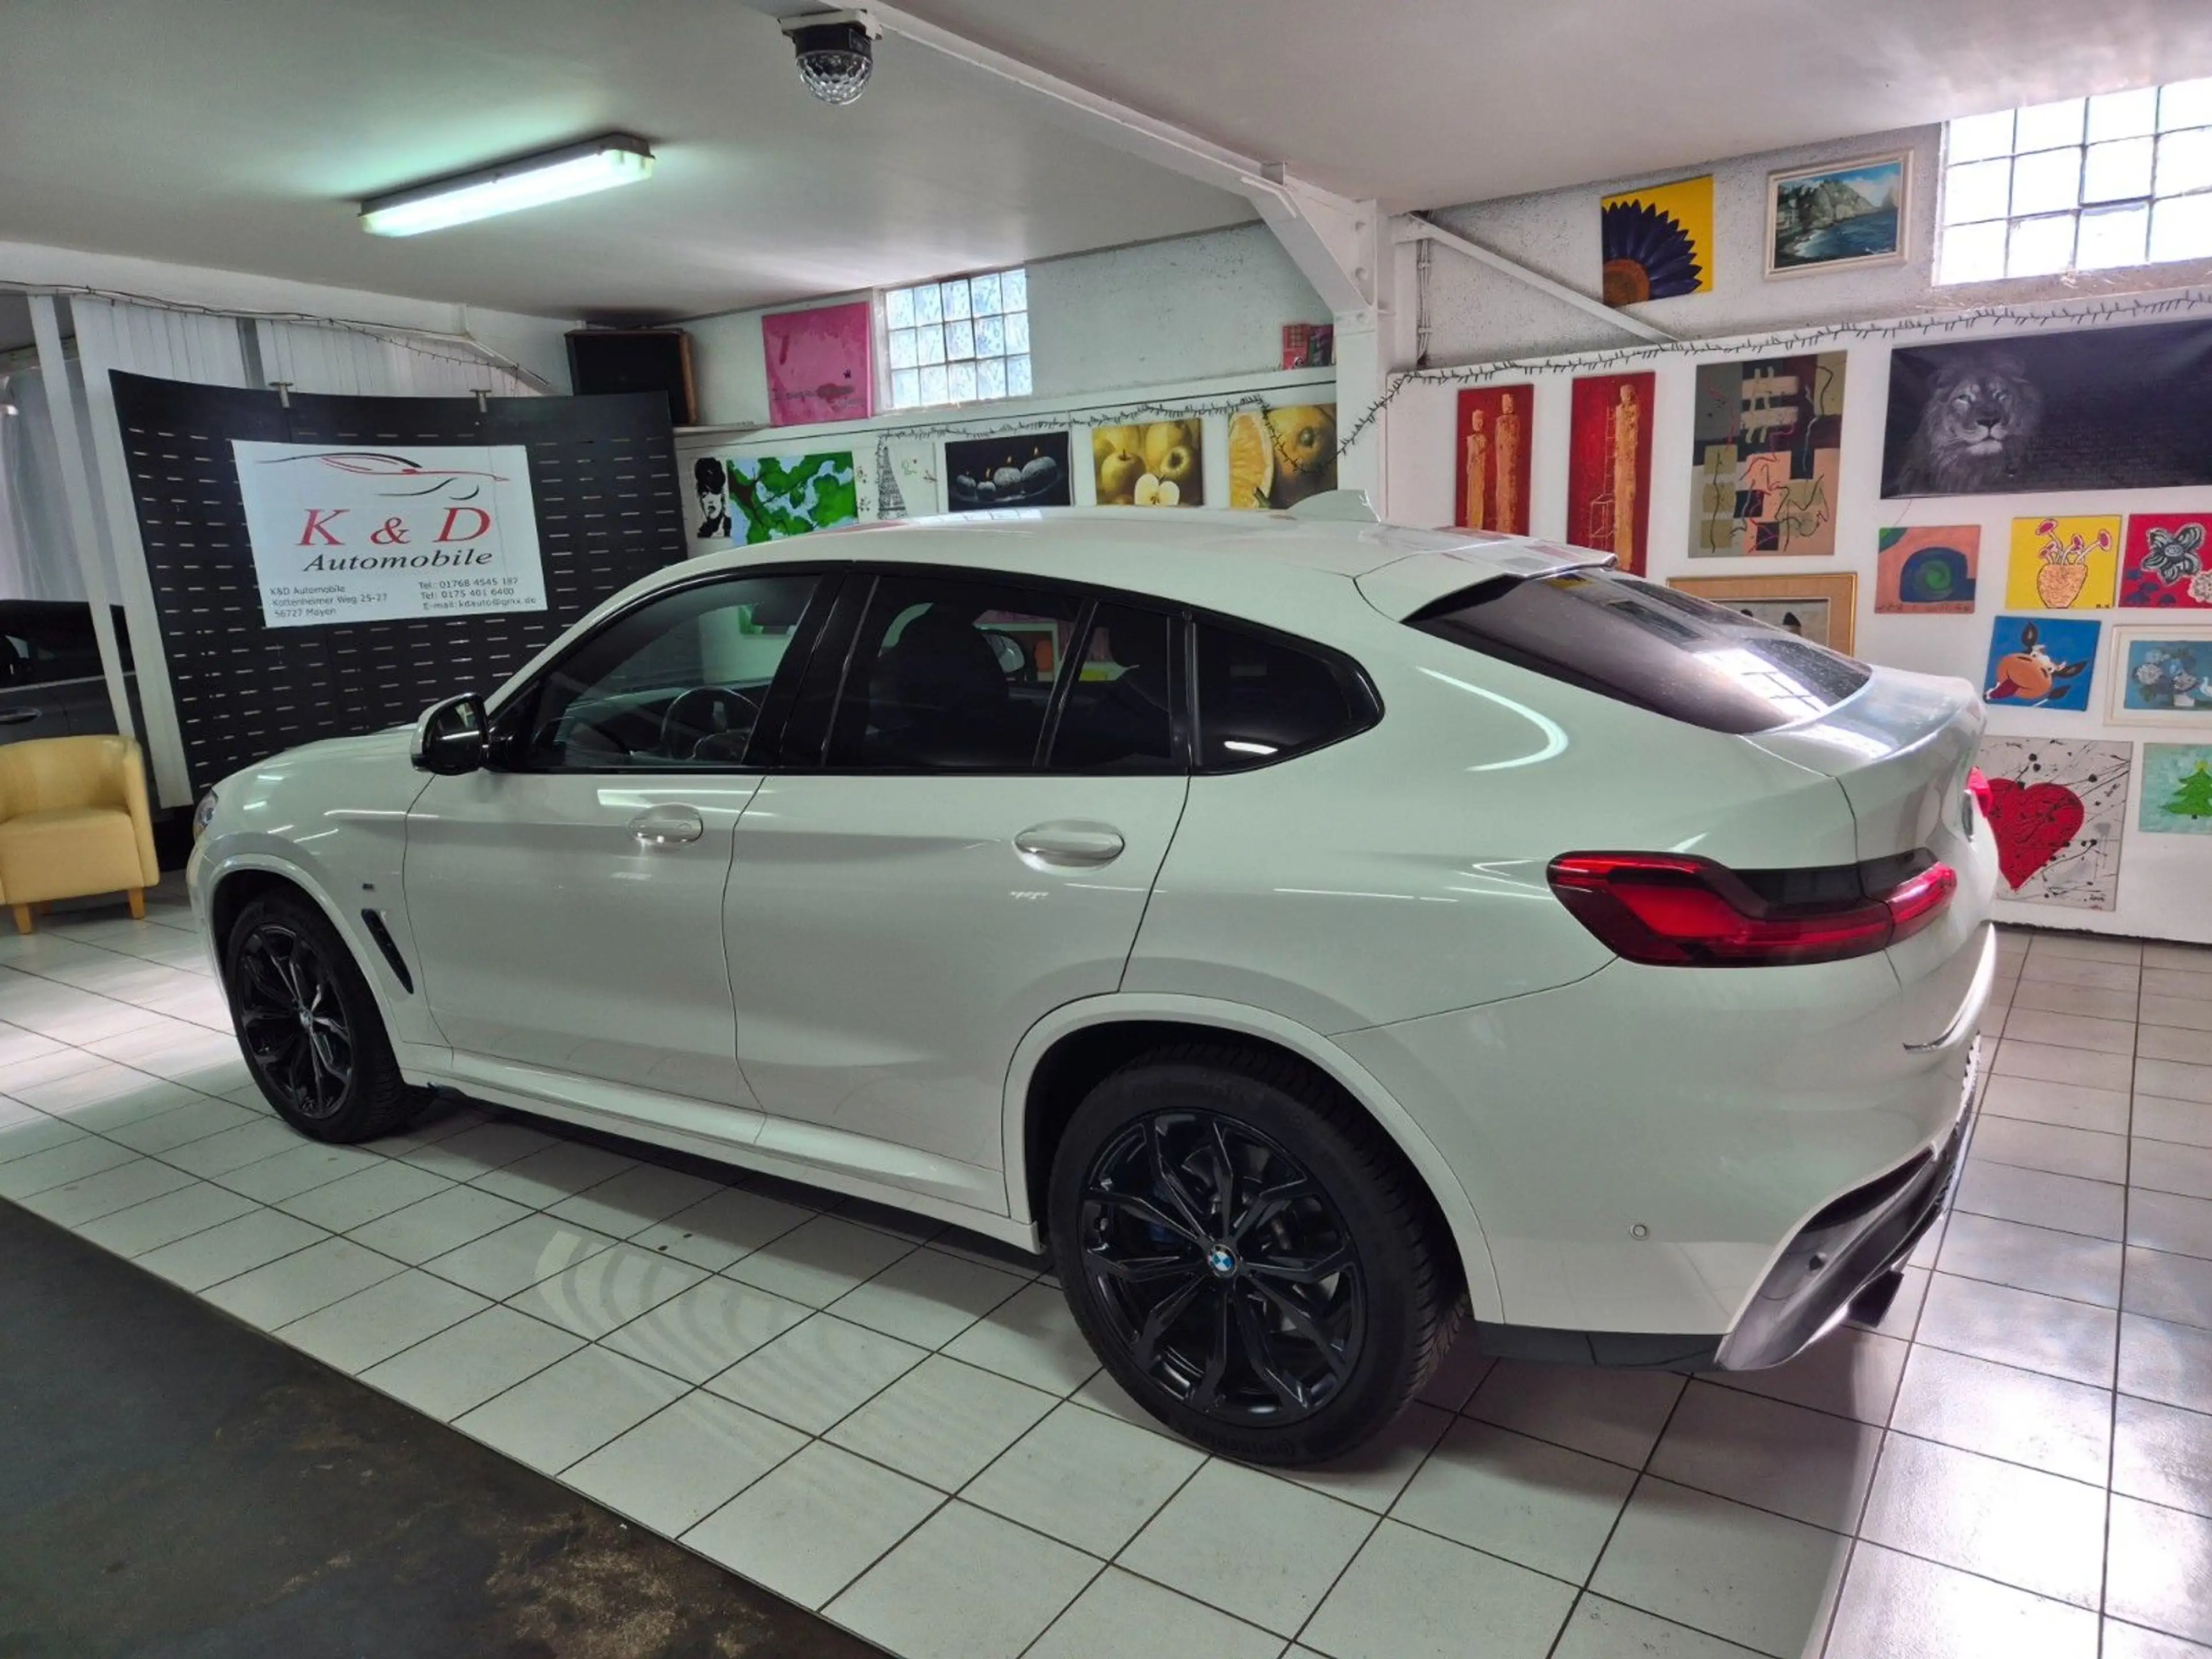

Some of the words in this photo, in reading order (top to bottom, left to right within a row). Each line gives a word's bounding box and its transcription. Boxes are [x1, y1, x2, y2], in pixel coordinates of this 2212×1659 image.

[295, 509, 350, 546] K
[369, 517, 411, 544] &
[432, 507, 491, 543] D
[302, 548, 493, 571] Automobile
[439, 579, 471, 589] 01768
[472, 578, 498, 586] 4545
[270, 586, 290, 596] K&D
[293, 585, 346, 595] Automobile
[441, 590, 465, 599] 0175
[490, 588, 514, 596] 6400
[337, 595, 358, 605] Weg
[274, 609, 302, 618] 56727
[306, 608, 336, 618] Mayen
